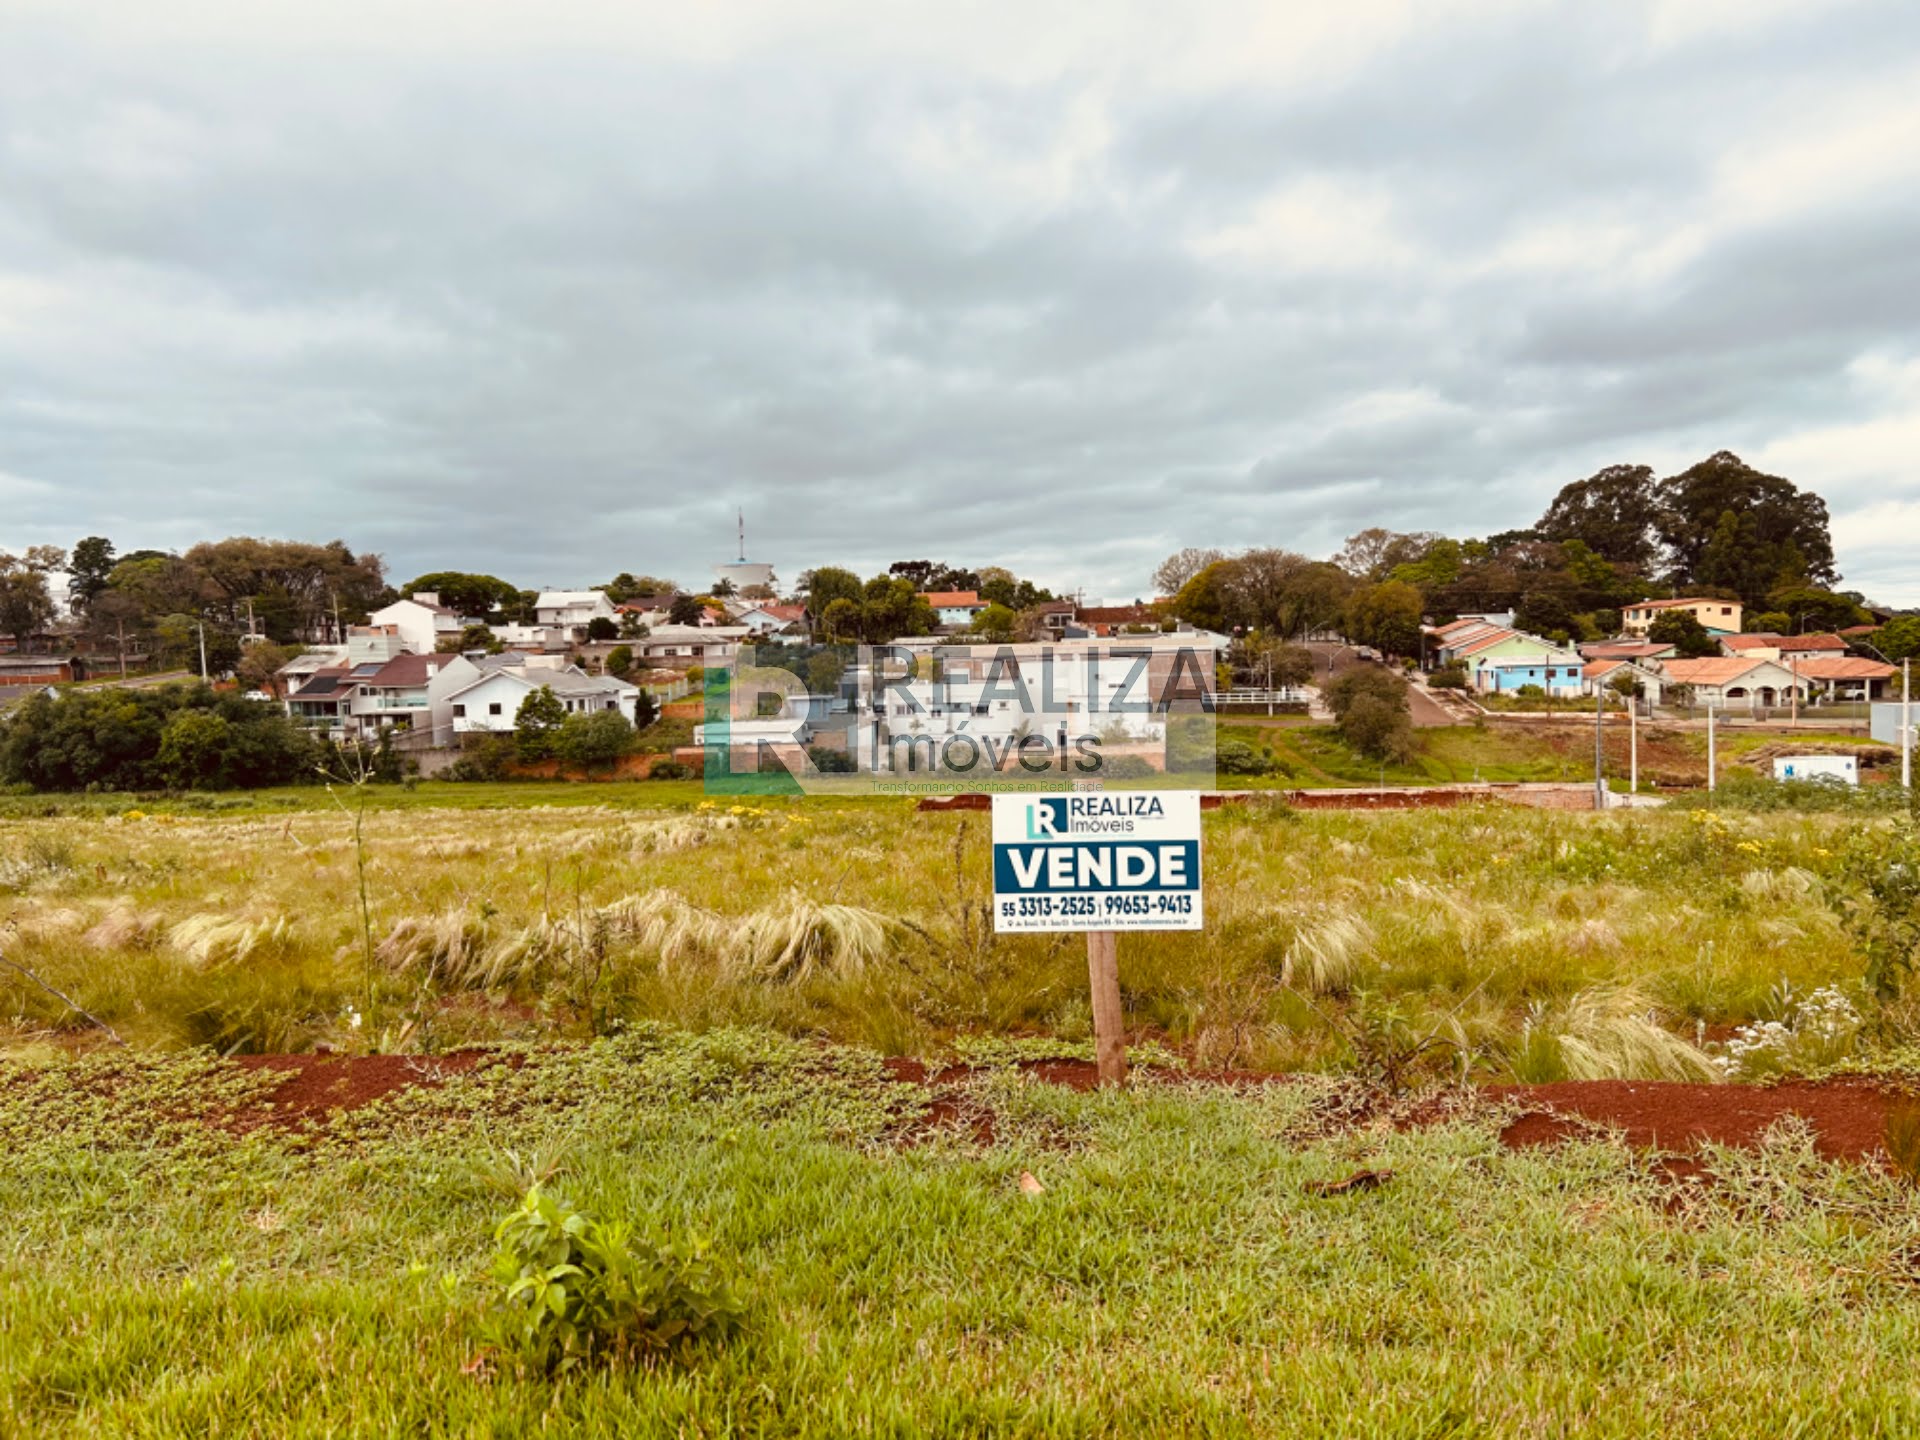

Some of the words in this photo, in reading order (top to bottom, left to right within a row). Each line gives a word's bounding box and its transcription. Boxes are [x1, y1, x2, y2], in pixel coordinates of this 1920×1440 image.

[1070, 796, 1164, 816] REALIZA
[1070, 816, 1134, 833] Imóveis
[1007, 845, 1188, 888] VENDE
[1002, 902, 1015, 917] 55
[1019, 896, 1096, 917] 3313-2525
[1105, 895, 1192, 915] 99653-9413
